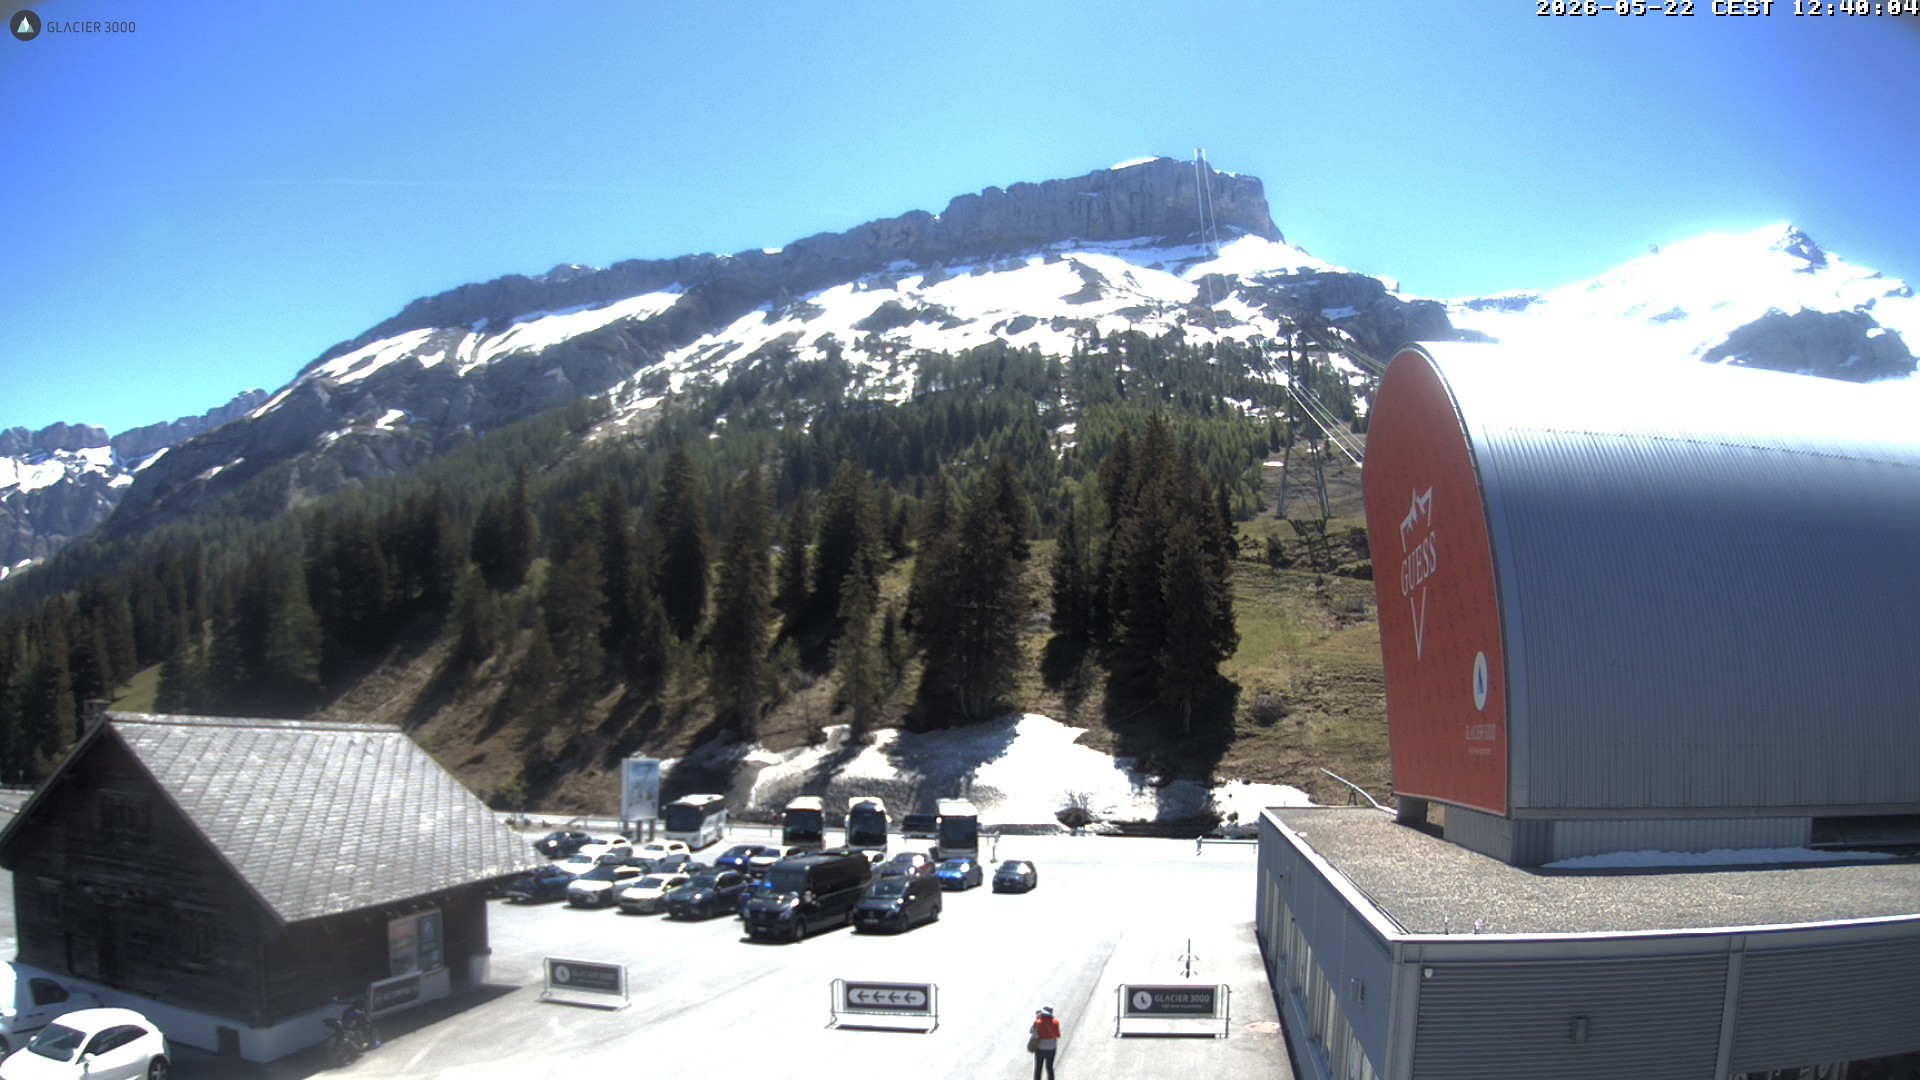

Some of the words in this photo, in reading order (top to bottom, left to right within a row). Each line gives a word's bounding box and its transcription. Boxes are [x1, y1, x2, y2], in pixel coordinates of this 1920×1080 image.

[1401, 531, 1437, 597] GUESS
[1154, 993, 1189, 1003] GLACIER
[1190, 993, 1210, 1003] 3000
